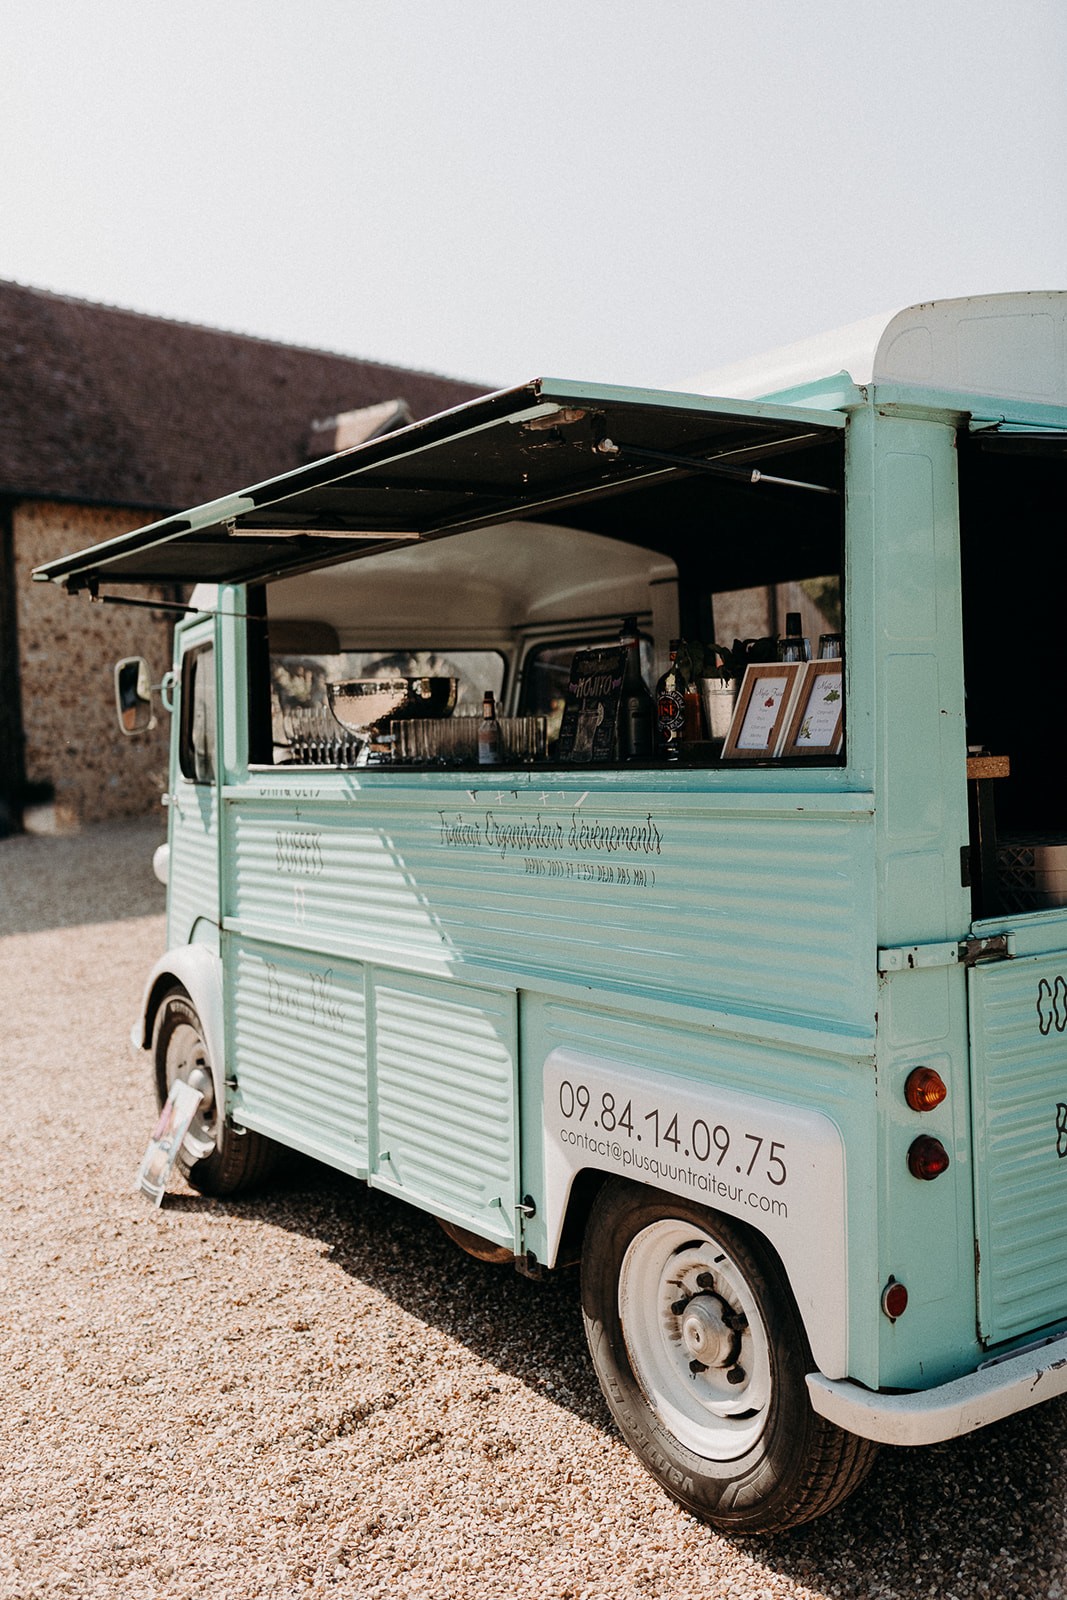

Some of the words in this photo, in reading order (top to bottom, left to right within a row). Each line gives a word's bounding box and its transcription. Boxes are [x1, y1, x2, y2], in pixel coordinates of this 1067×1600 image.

[575, 675, 613, 698] MOJITO
[275, 831, 324, 875] BUFFETS
[485, 811, 565, 860] Organisateur
[524, 858, 546, 875] DEPUIS
[566, 862, 574, 879] ET
[617, 867, 631, 885] PAS
[633, 869, 647, 887] MAL
[559, 1080, 787, 1186] 09.84.14.09.75
[560, 1128, 788, 1219] contact@plusquuntraiteur.com
